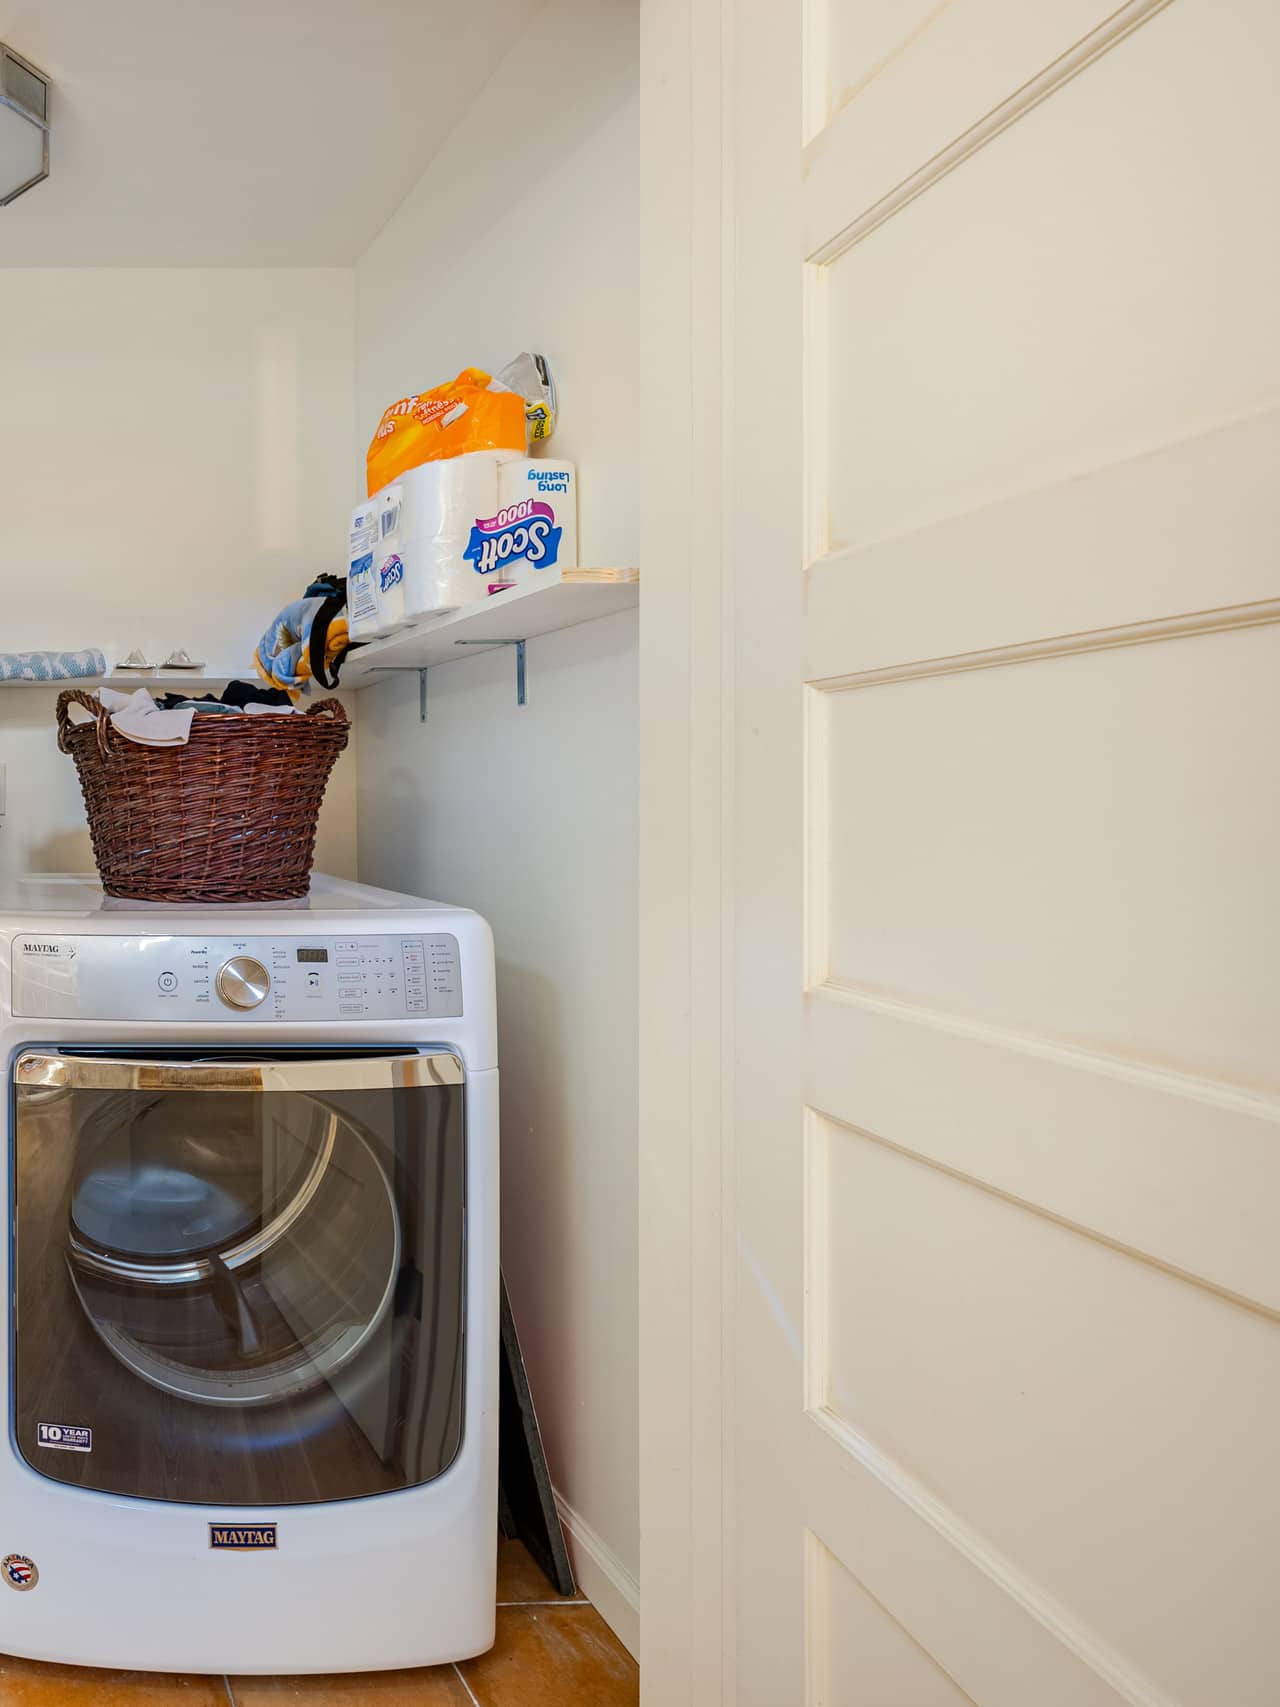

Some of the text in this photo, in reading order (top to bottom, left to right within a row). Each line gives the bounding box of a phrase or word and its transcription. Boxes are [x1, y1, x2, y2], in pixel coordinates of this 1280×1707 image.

[497, 498, 534, 527] 1000
[477, 520, 550, 574] Scott
[23, 943, 59, 953] MAYTAG
[40, 1425, 89, 1441] 10 YEAR
[213, 1530, 274, 1545] MAYTAG
